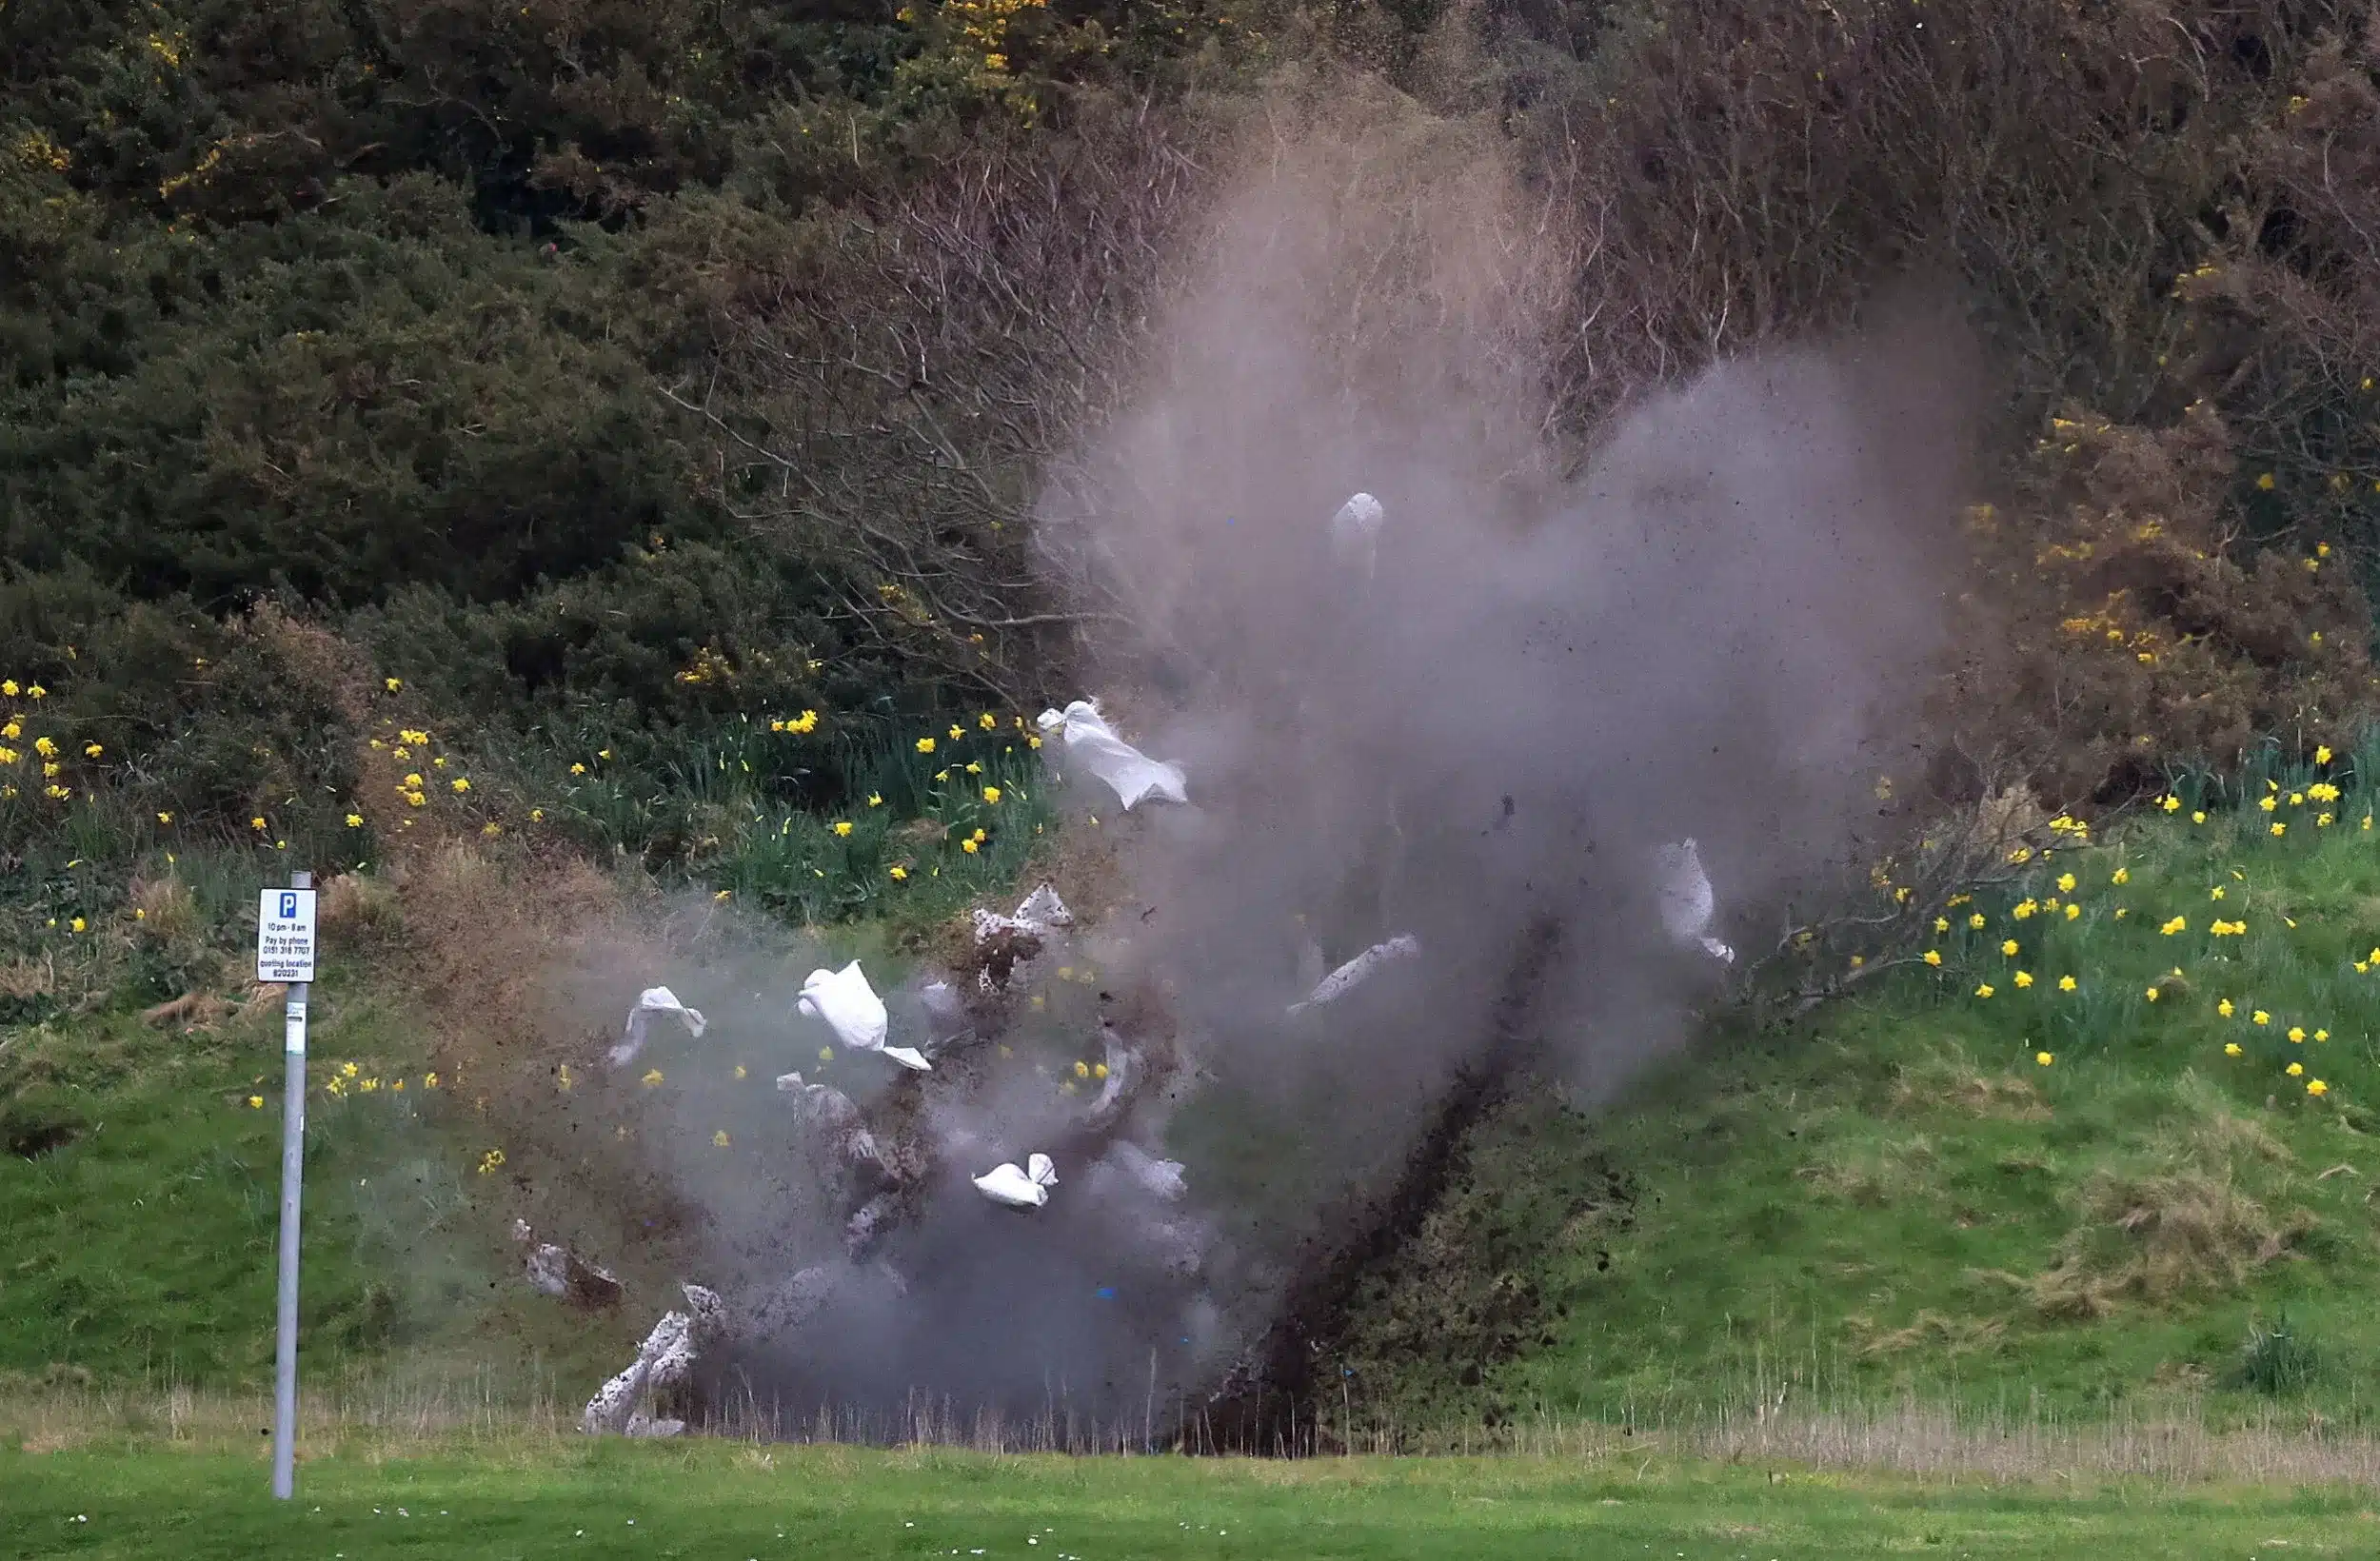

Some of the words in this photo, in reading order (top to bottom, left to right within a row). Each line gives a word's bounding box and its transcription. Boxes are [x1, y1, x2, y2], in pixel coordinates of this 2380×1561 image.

[284, 895, 294, 916] P
[266, 936, 277, 945] Pay
[278, 937, 287, 945] by
[288, 937, 308, 947] phone
[260, 960, 285, 969] quoting
[286, 959, 312, 968] location
